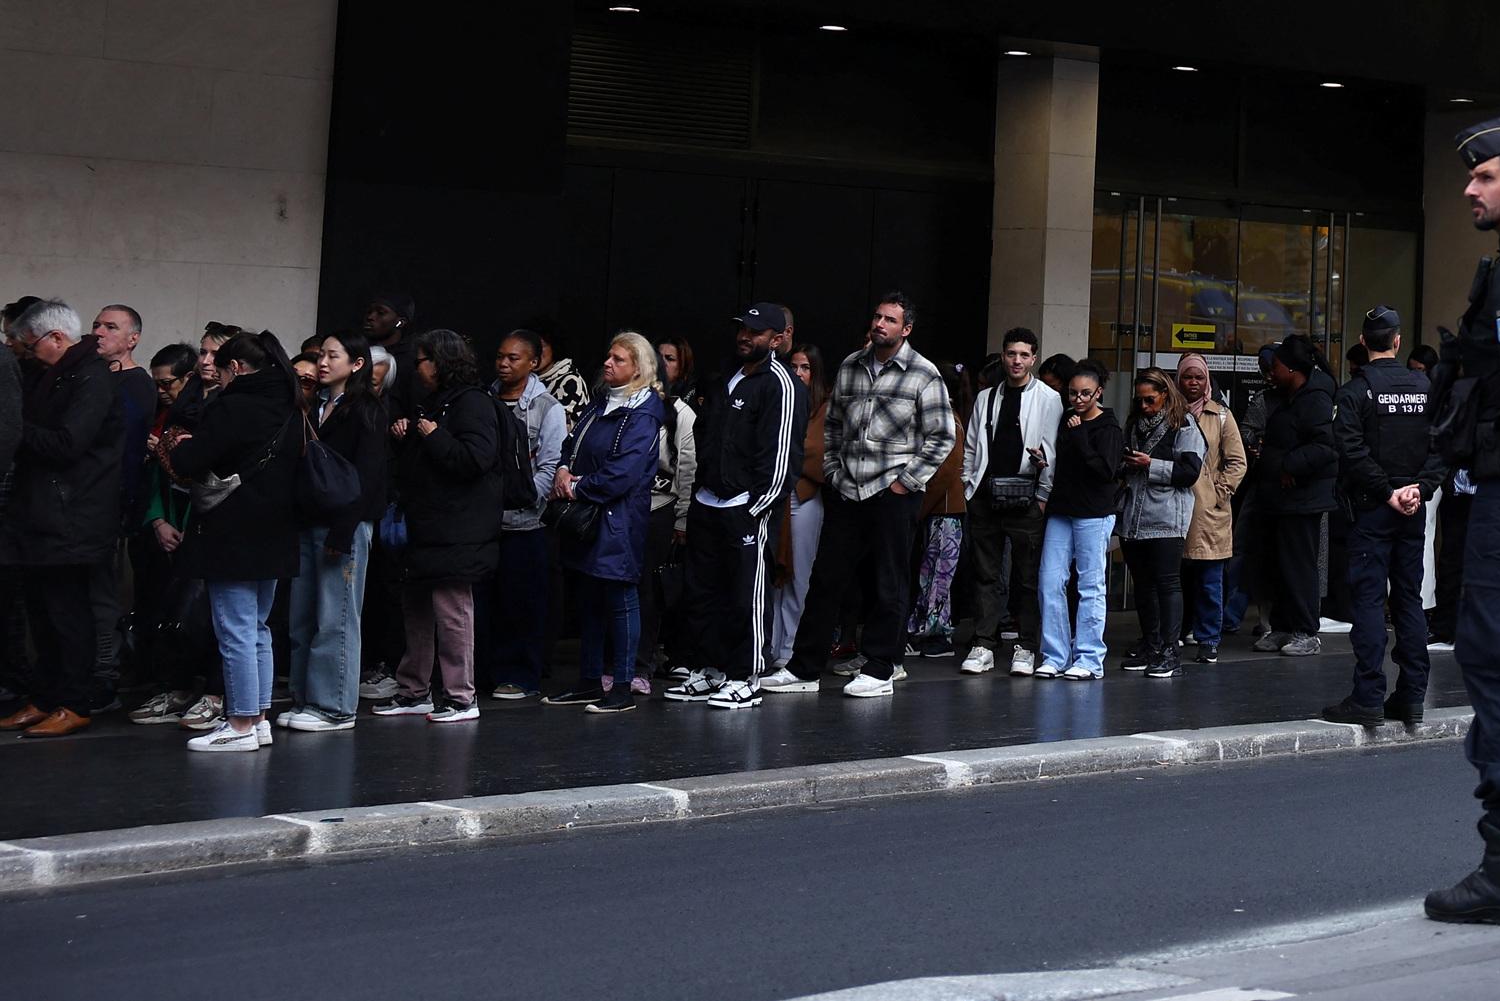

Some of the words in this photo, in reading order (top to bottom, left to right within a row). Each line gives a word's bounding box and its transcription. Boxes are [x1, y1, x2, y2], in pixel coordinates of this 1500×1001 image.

[1378, 393, 1428, 404] GENDARMERI
[1388, 404, 1397, 413] B
[1401, 404, 1424, 413] 13/9
